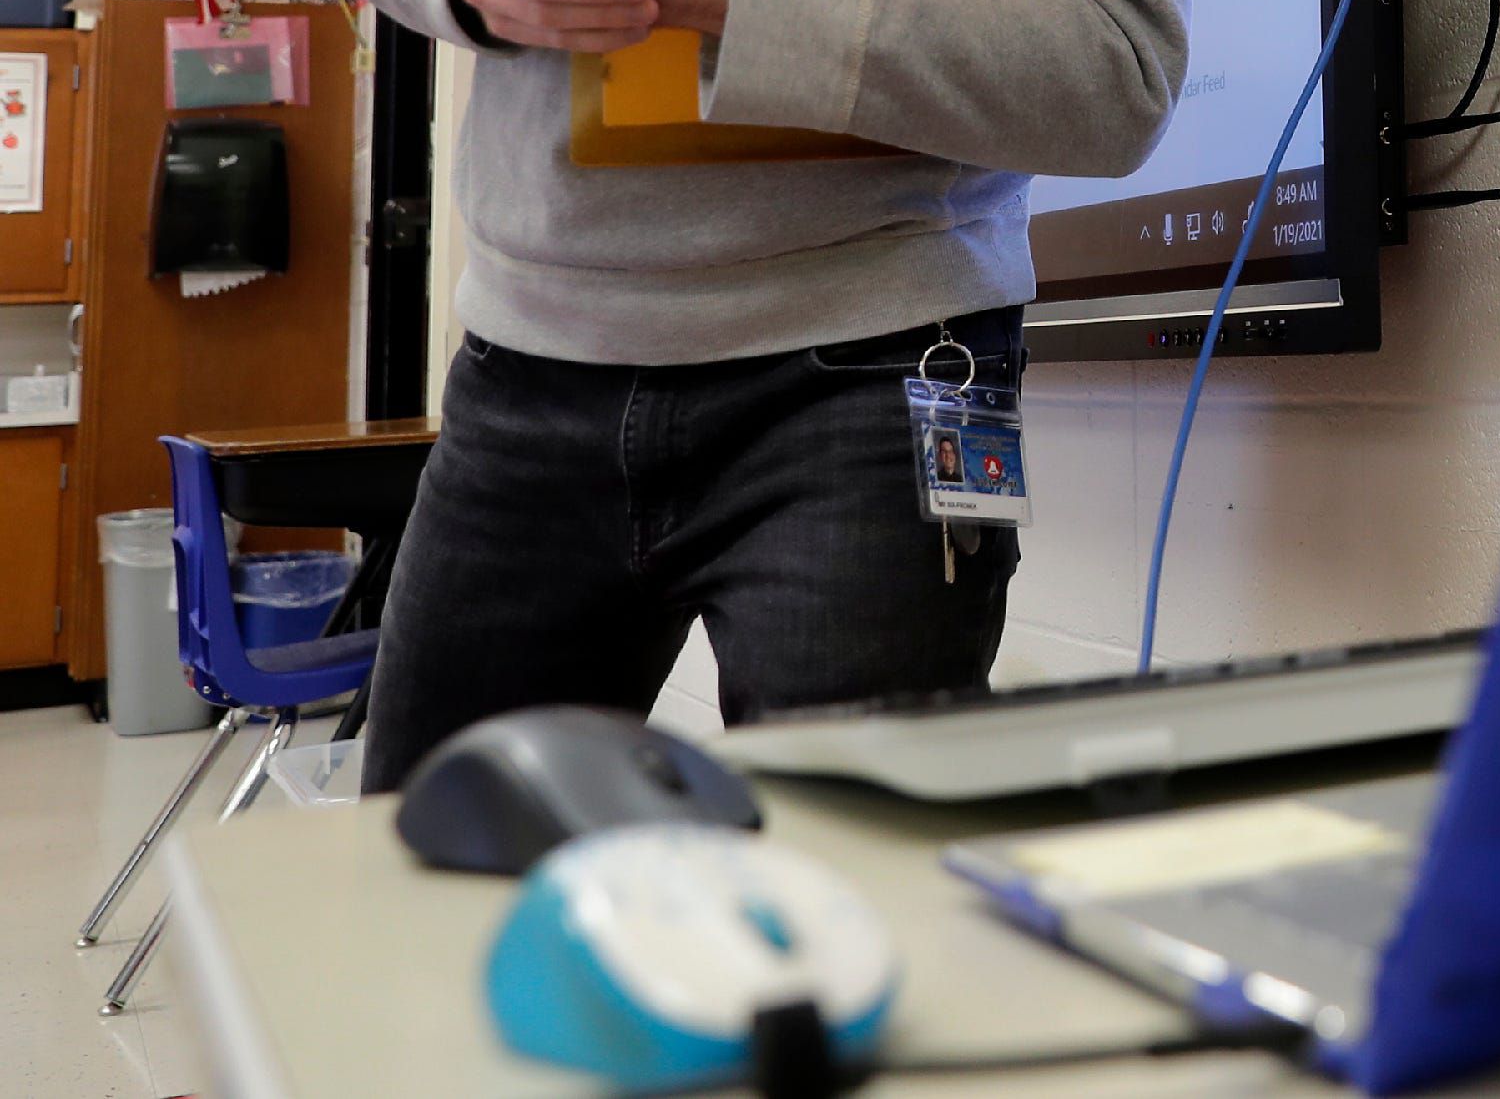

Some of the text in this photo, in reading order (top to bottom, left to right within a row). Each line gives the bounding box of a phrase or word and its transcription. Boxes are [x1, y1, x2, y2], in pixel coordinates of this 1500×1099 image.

[1203, 70, 1226, 96] Feed
[1275, 180, 1318, 206] 8:49 AM
[1273, 219, 1323, 248] 1/19/2021
